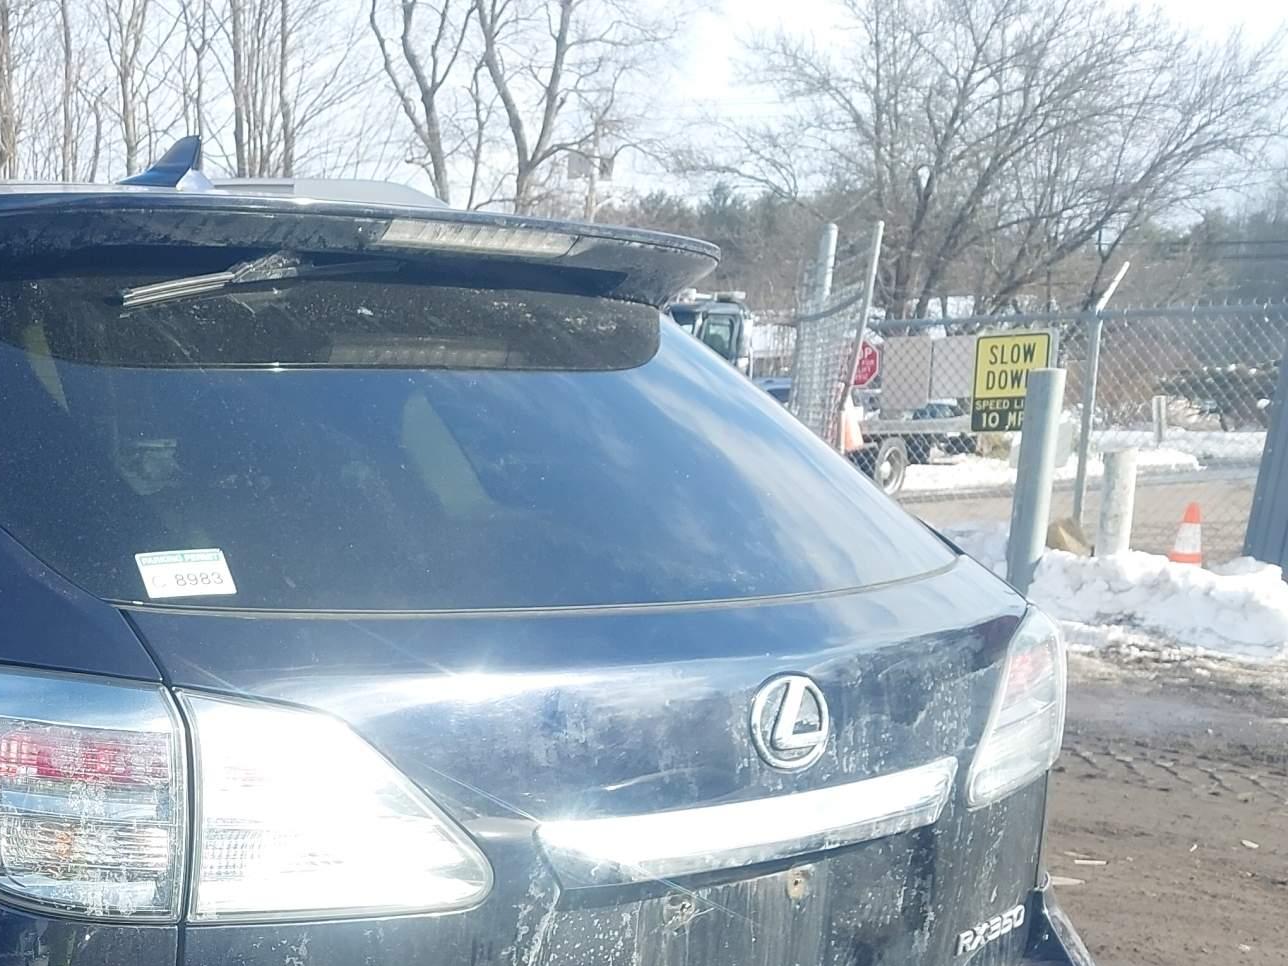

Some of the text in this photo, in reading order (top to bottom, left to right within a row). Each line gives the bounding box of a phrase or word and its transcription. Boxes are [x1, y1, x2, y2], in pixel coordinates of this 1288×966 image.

[988, 342, 1037, 366] SLOW
[975, 399, 1011, 411] SPEED
[982, 410, 1025, 428] 10 MP
[174, 571, 224, 587] 8983
